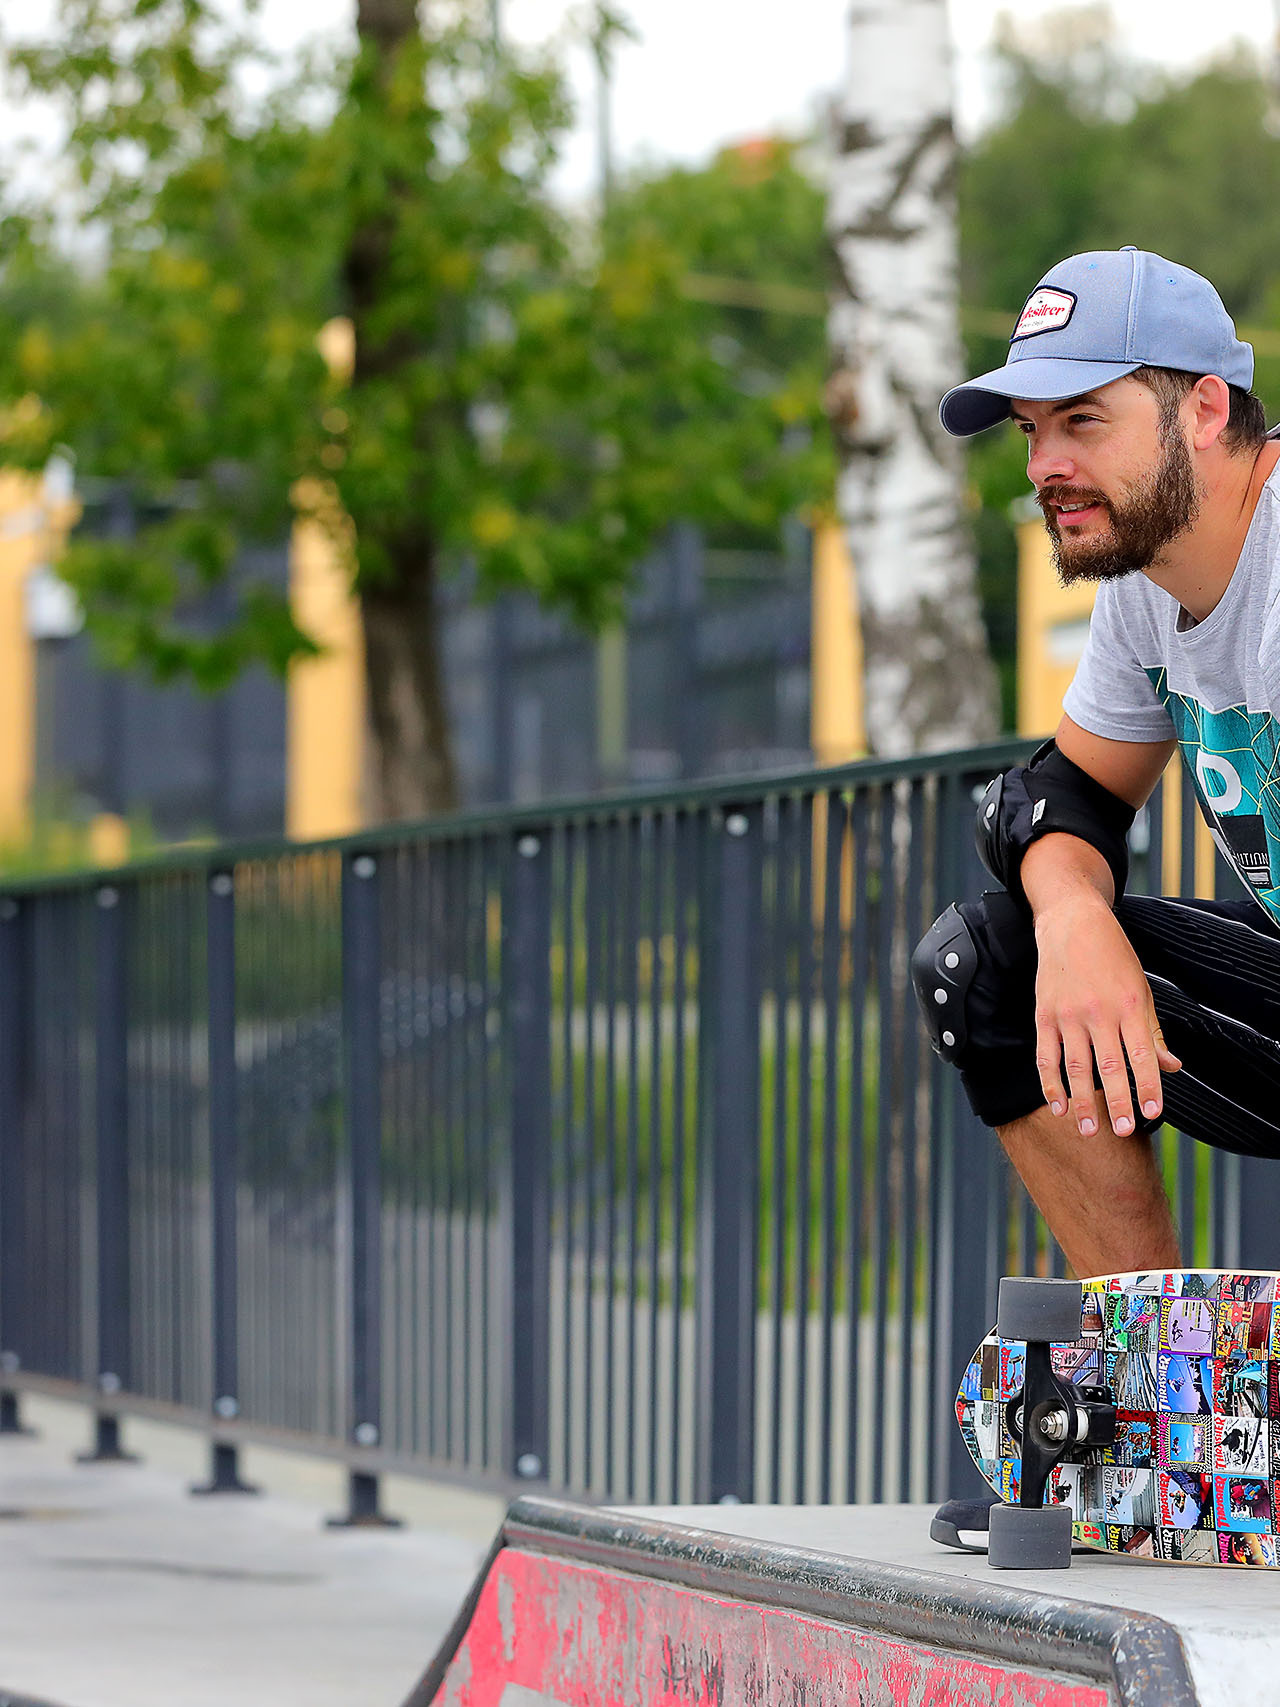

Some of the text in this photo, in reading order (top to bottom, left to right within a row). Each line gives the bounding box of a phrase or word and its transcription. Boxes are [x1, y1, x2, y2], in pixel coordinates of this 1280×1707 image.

[1159, 1297, 1175, 1350] THRASHER
[1158, 1355, 1173, 1412] THRASHER
[1213, 1416, 1227, 1470] THRASHER
[1160, 1473, 1175, 1527] THRASHER
[1083, 1524, 1092, 1538] 19
